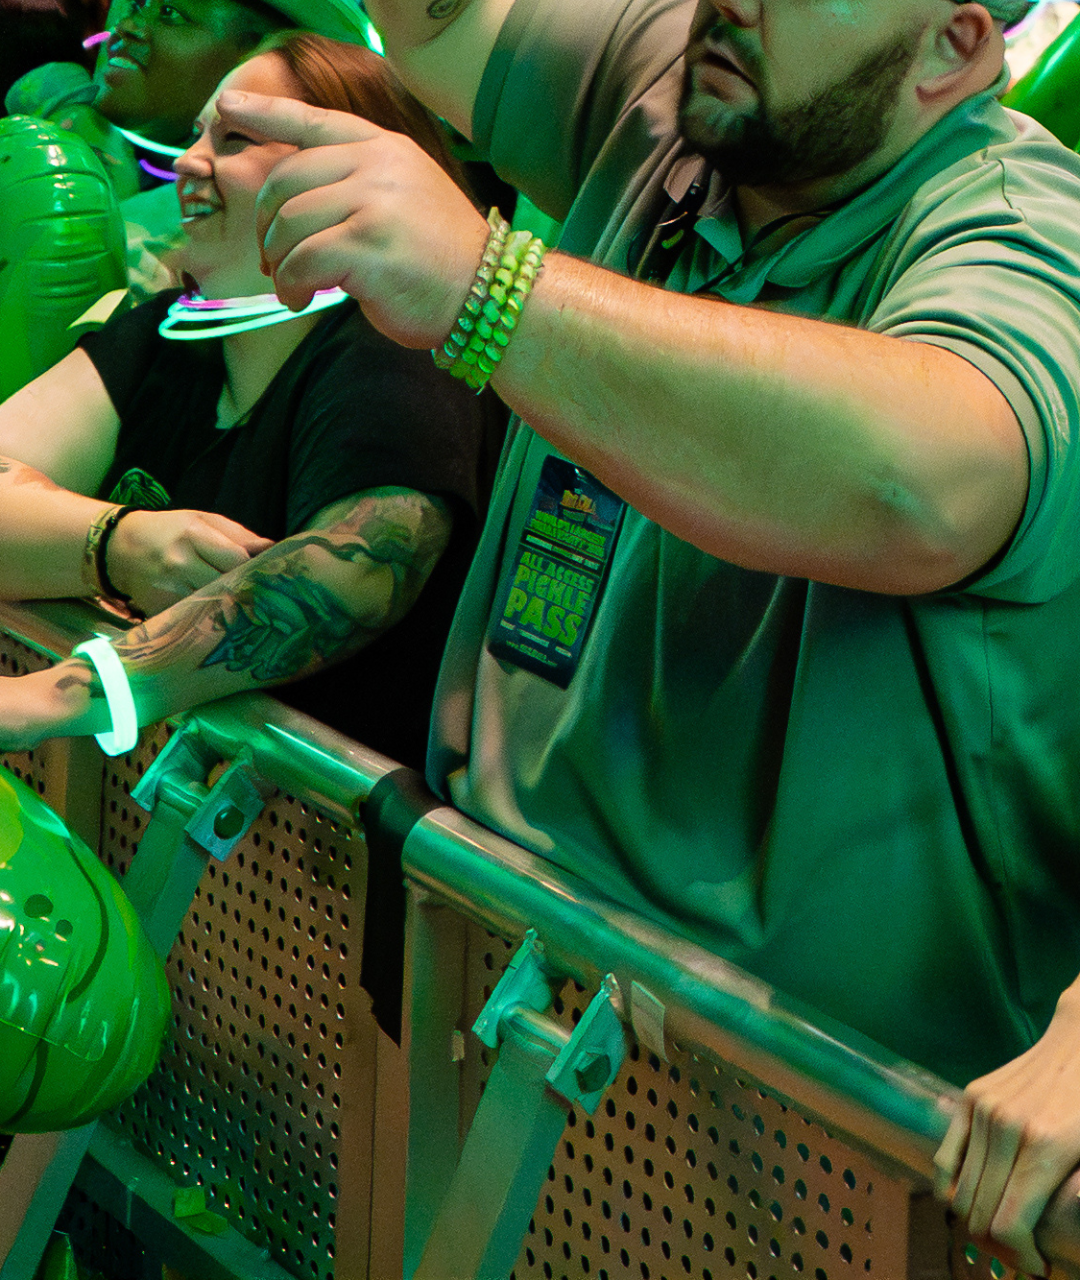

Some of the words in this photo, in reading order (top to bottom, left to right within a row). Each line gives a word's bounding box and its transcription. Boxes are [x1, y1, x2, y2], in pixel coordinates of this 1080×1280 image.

[514, 564, 591, 616] PICKLE
[520, 551, 544, 572] ALL
[544, 561, 595, 593] ACCESS
[503, 586, 582, 647] PASS
